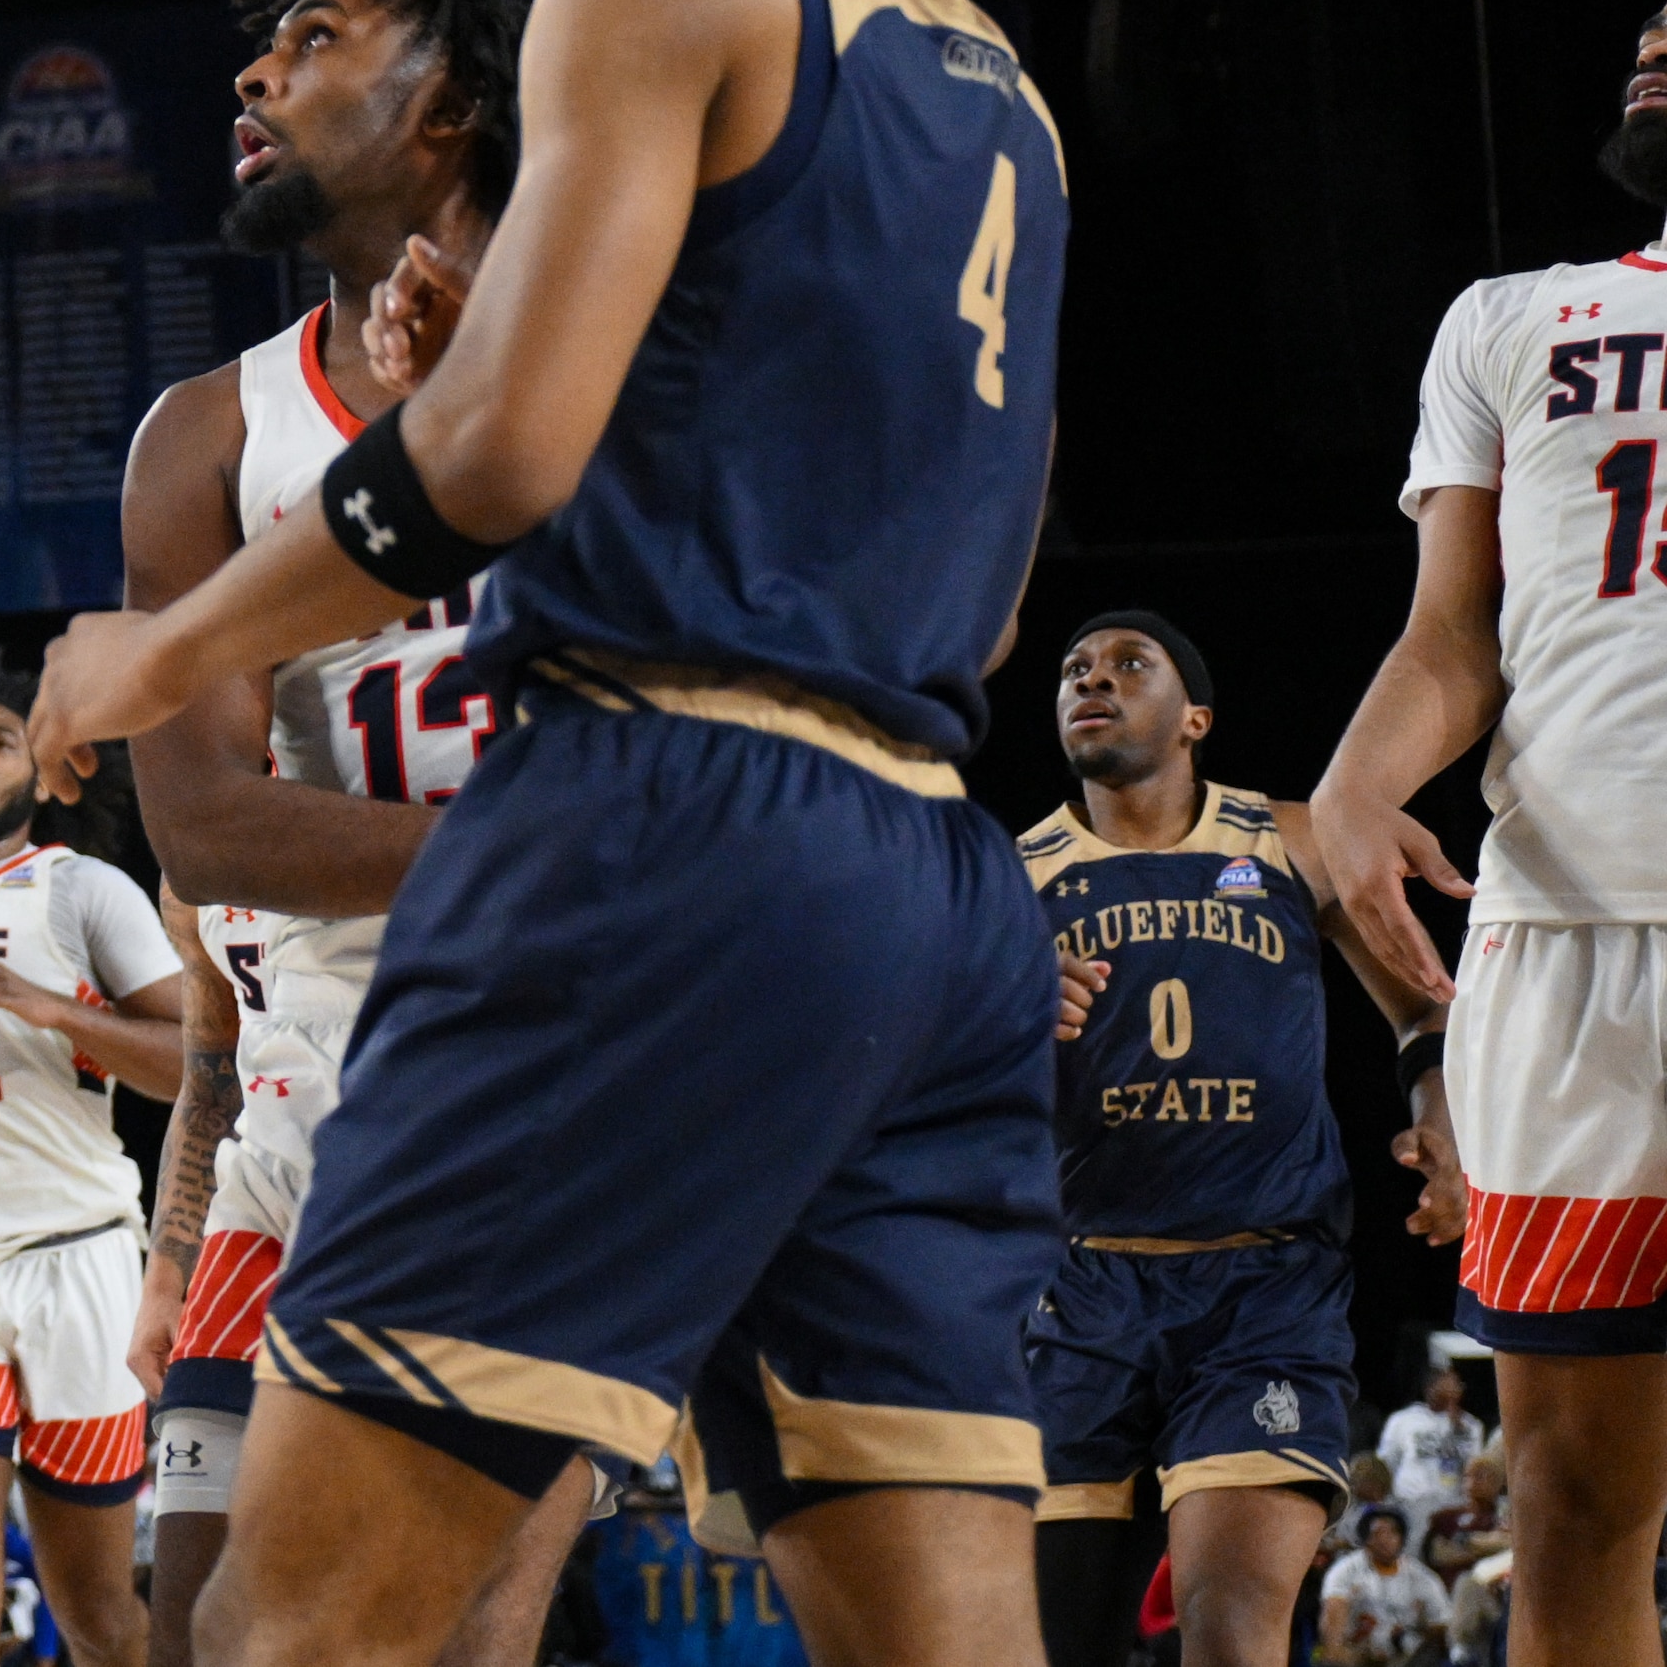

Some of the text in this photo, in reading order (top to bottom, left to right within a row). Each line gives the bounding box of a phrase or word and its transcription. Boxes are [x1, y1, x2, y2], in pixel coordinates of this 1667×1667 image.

[957, 150, 1017, 410] 4
[1545, 332, 1667, 423] ST
[1595, 438, 1667, 599] 1
[1219, 871, 1261, 886] CIAA
[1148, 977, 1194, 1061] 0
[1101, 1078, 1257, 1128] STATE
[640, 1563, 781, 1625] TITL
